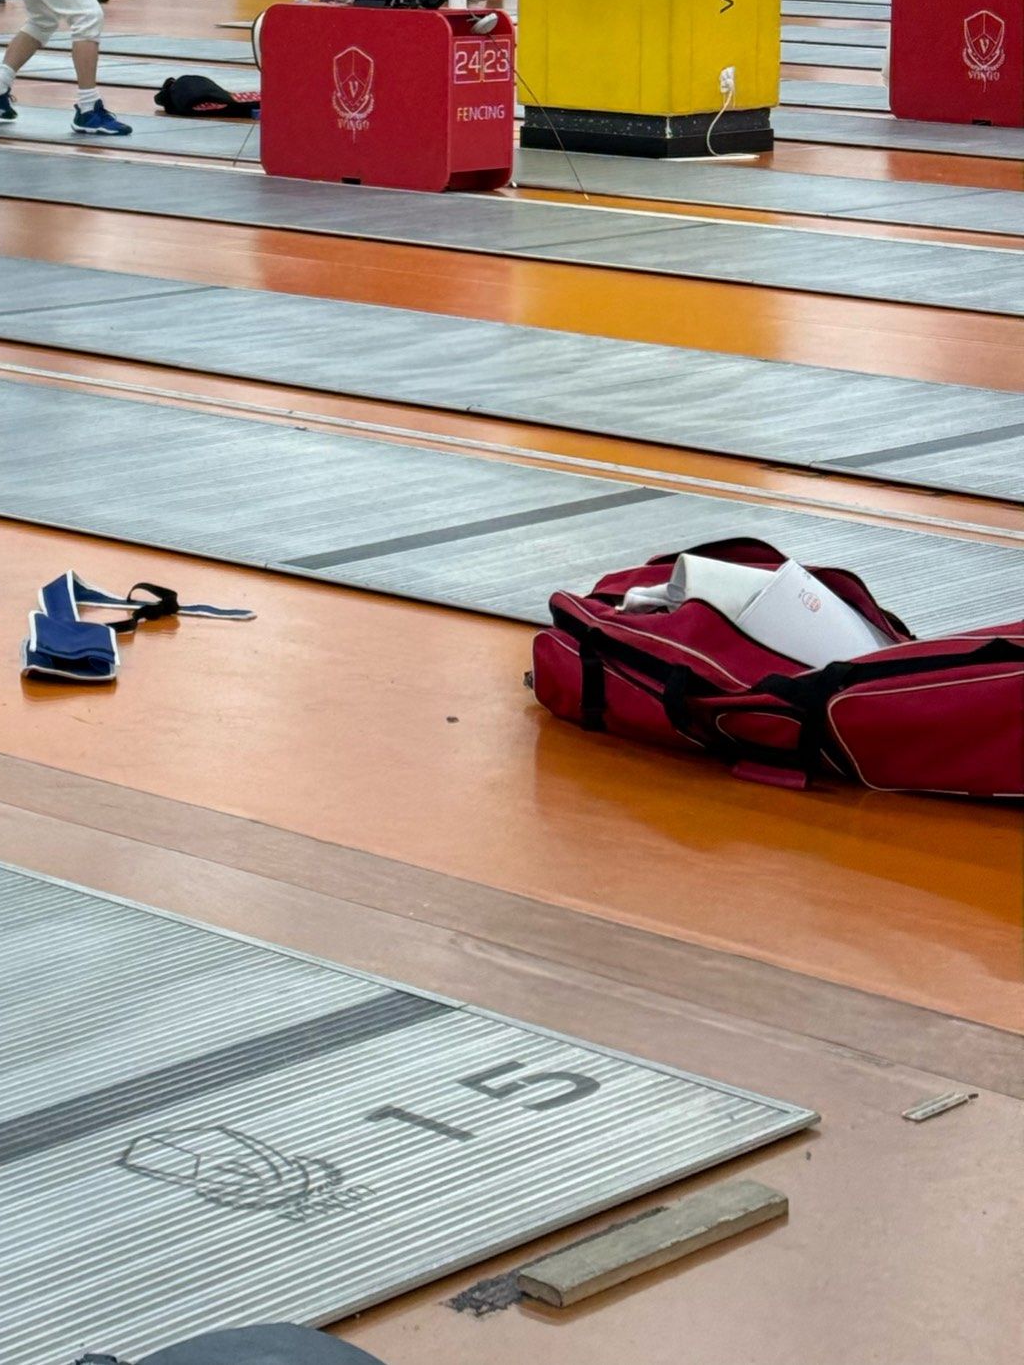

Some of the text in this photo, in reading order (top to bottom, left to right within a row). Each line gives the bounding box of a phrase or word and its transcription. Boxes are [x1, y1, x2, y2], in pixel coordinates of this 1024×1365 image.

[455, 48, 510, 75] 24 23
[457, 104, 505, 122] FENCING
[365, 1060, 601, 1143] 15
